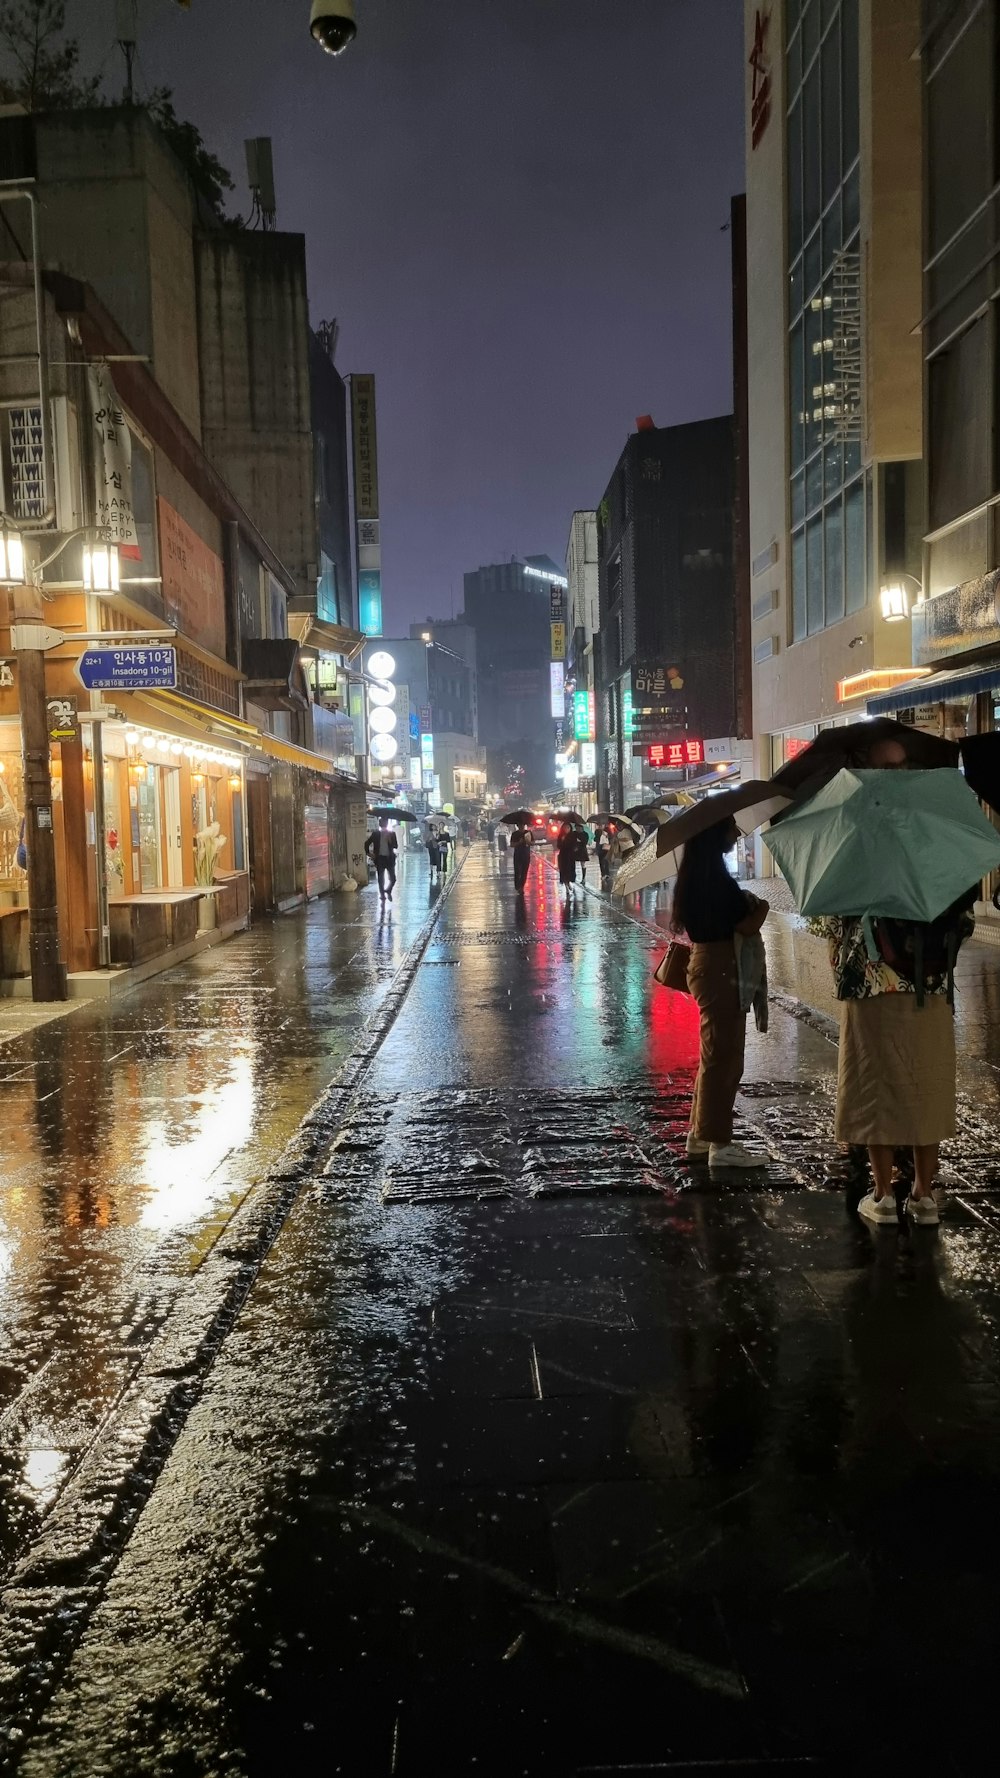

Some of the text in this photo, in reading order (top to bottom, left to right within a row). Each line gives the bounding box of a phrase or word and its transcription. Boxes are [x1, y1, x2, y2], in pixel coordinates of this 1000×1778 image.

[833, 248, 861, 339] GALLERY
[833, 347, 861, 400] STAR
[113, 651, 172, 665] 인사동10길
[112, 666, 173, 676] Insadong 10-gil
[638, 668, 665, 680] 인사동
[635, 679, 667, 698] 마루
[650, 741, 701, 765] 루프탑
